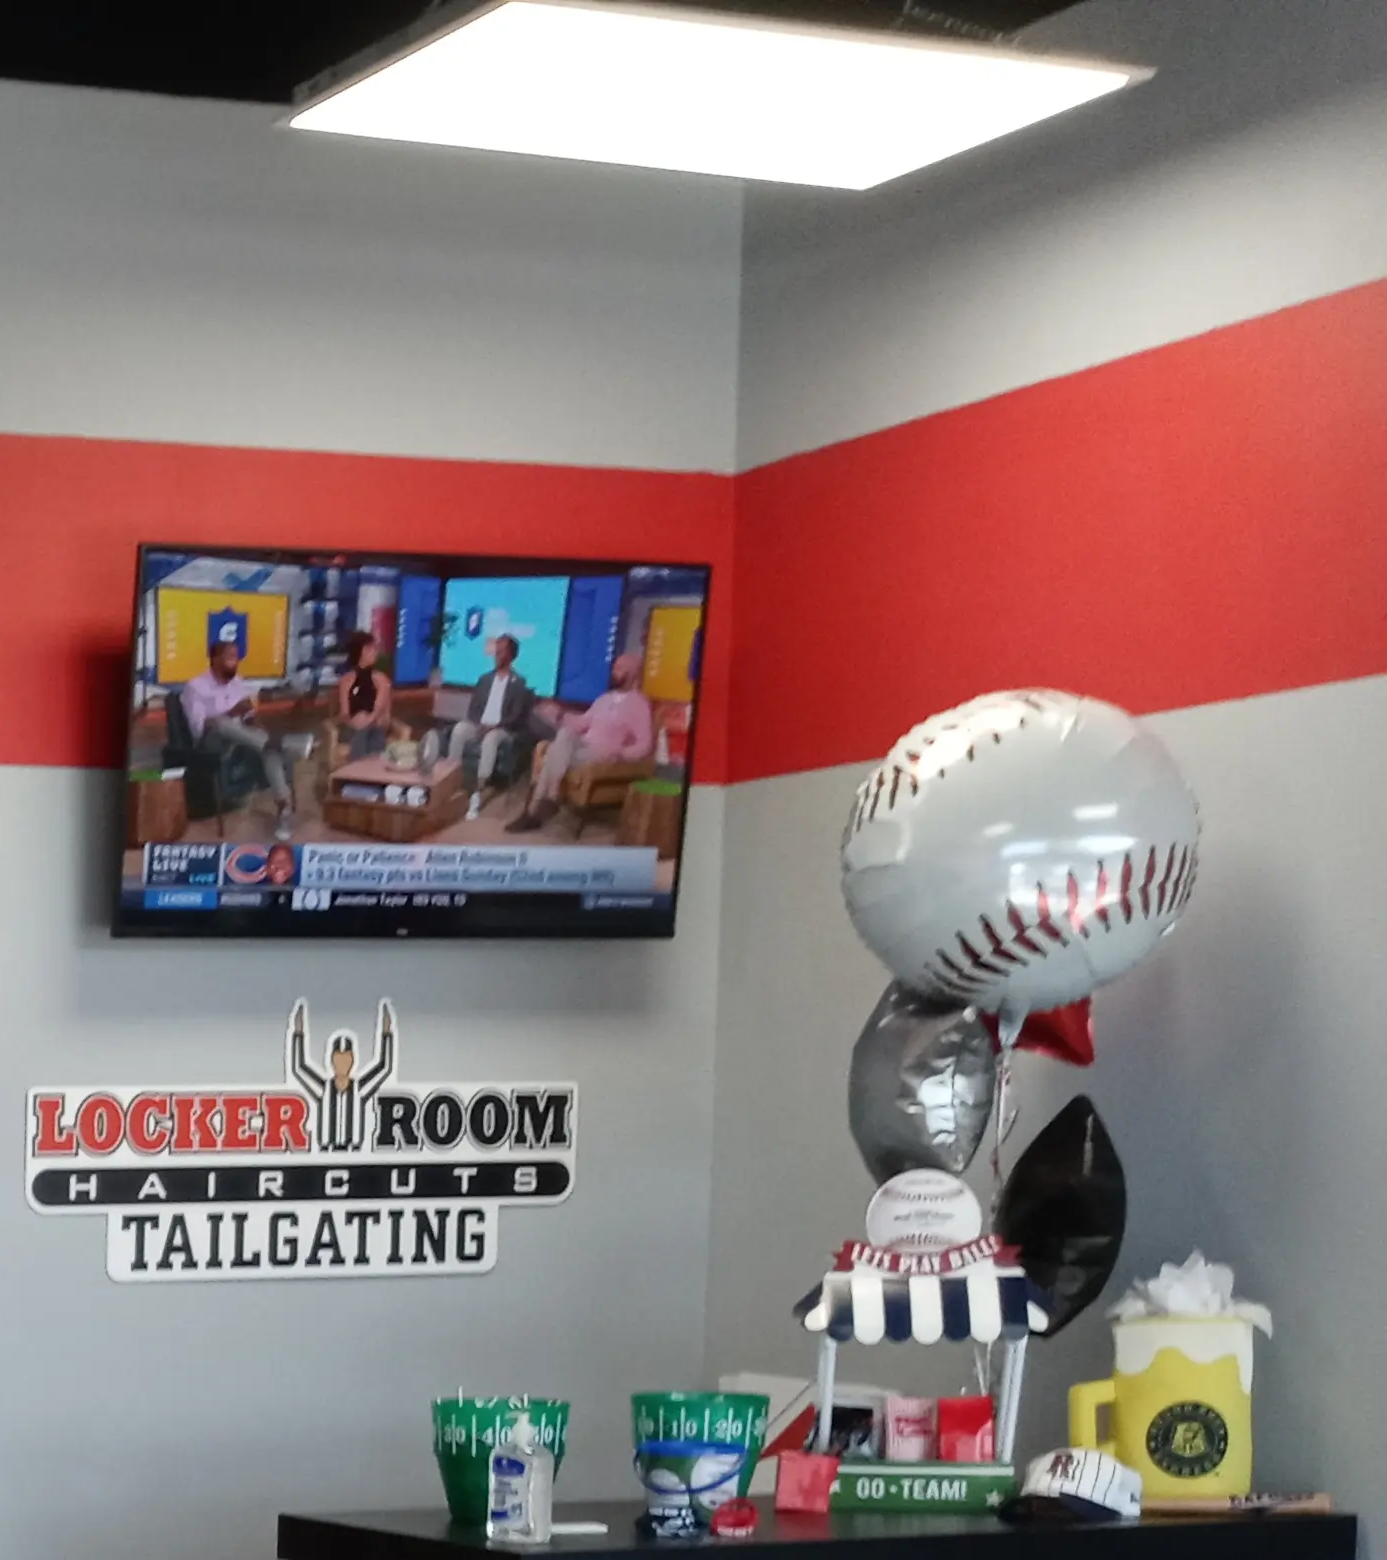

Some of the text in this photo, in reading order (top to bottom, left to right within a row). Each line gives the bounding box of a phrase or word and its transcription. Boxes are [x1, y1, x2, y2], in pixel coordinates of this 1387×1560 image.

[33, 1088, 575, 1157] LOCKER ROOM
[68, 1165, 539, 1201] HAIRCUTS
[122, 1207, 488, 1273] TAILGATING
[900, 1477, 968, 1501] TEAM!
